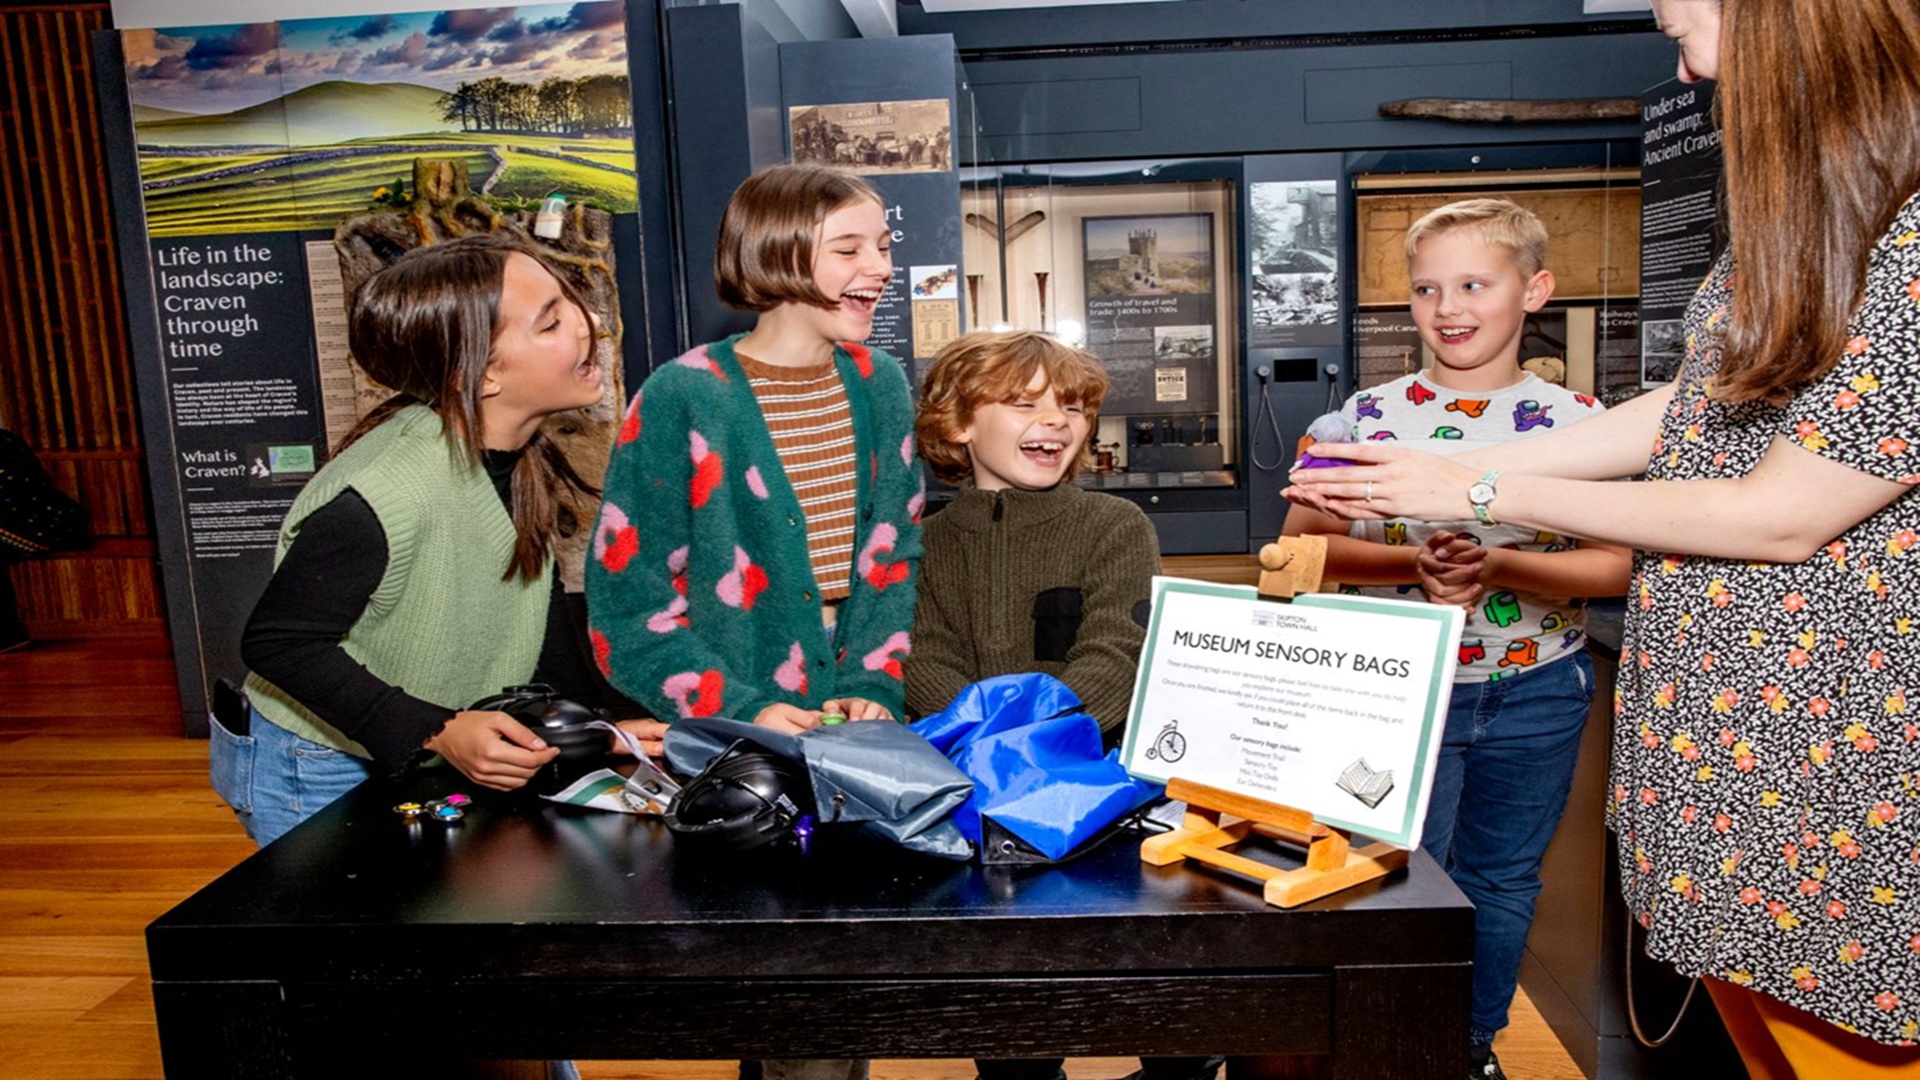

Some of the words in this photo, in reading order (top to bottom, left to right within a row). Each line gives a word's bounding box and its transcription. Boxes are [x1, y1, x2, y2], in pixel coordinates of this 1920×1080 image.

[1644, 97, 1676, 121] Under
[1676, 90, 1696, 109] sea
[1644, 121, 1663, 144] and
[1663, 112, 1704, 138] swamp:
[1643, 139, 1682, 167] Ancient
[158, 246, 201, 266] Life
[206, 245, 228, 264] in
[233, 243, 272, 263] the
[161, 269, 284, 290] landscape:
[164, 295, 247, 313] Craven
[1089, 299, 1122, 308] Growth
[1123, 298, 1134, 307] of
[1134, 298, 1159, 307] travel
[1160, 297, 1178, 305] and
[1116, 307, 1141, 316] 1400s
[1154, 306, 1178, 314] 1700s
[167, 313, 259, 337] through
[1394, 325, 1419, 333] Cana
[1611, 319, 1639, 327] Crave
[170, 339, 223, 358] time
[182, 449, 221, 463] What
[224, 448, 237, 462] is
[185, 464, 246, 478] Craven?
[1276, 614, 1307, 623] SKIPTON
[1276, 620, 1299, 630] TOWN
[1299, 622, 1318, 632] HALL
[1173, 629, 1251, 655] MUSEUM
[1255, 640, 1348, 668] SENSORY
[1353, 653, 1411, 678] BAGS
[1252, 717, 1271, 727] Thank
[1273, 721, 1289, 730] You!
[1229, 733, 1242, 741] Our
[1243, 737, 1265, 747] sensory
[1266, 740, 1279, 750] bags
[1279, 744, 1302, 753] include:
